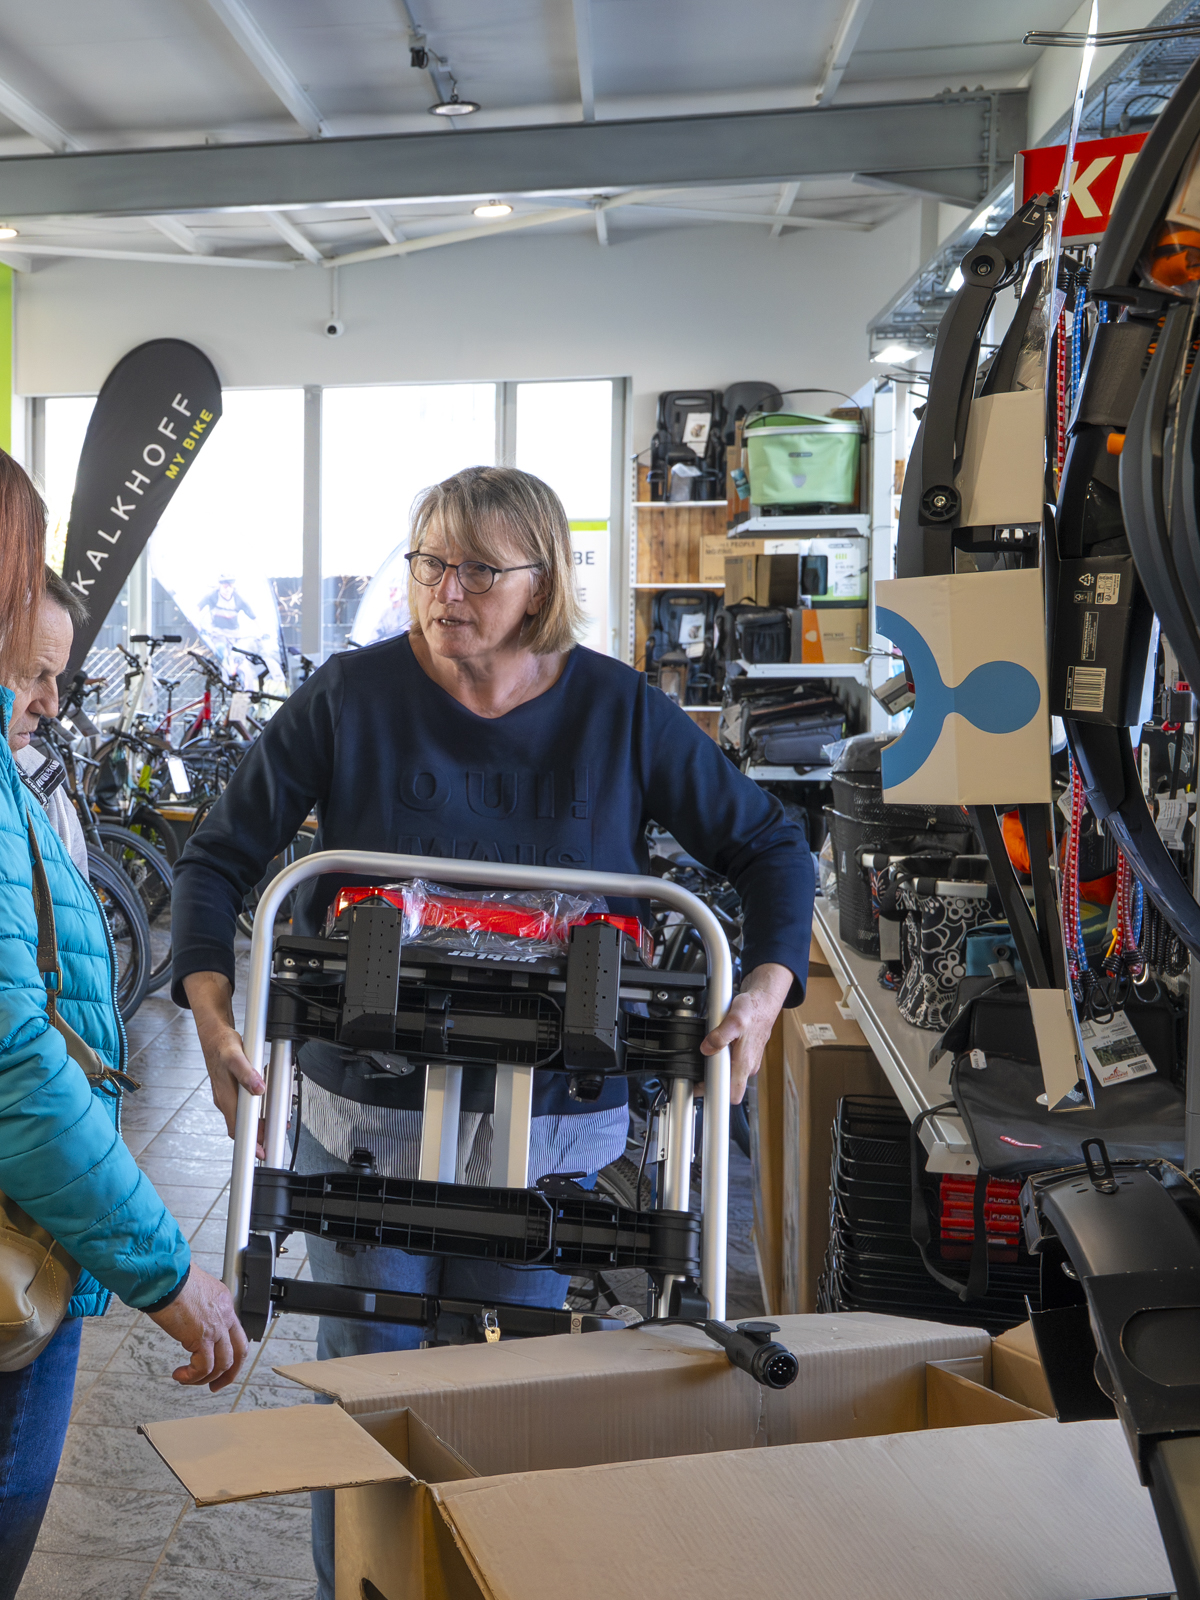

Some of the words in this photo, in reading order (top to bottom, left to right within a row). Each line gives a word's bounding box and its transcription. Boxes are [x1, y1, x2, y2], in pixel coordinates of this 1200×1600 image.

[165, 452, 186, 479] MY
[182, 408, 213, 451] BIKE
[71, 393, 191, 595] KALKHOFF
[573, 550, 595, 566] BE
